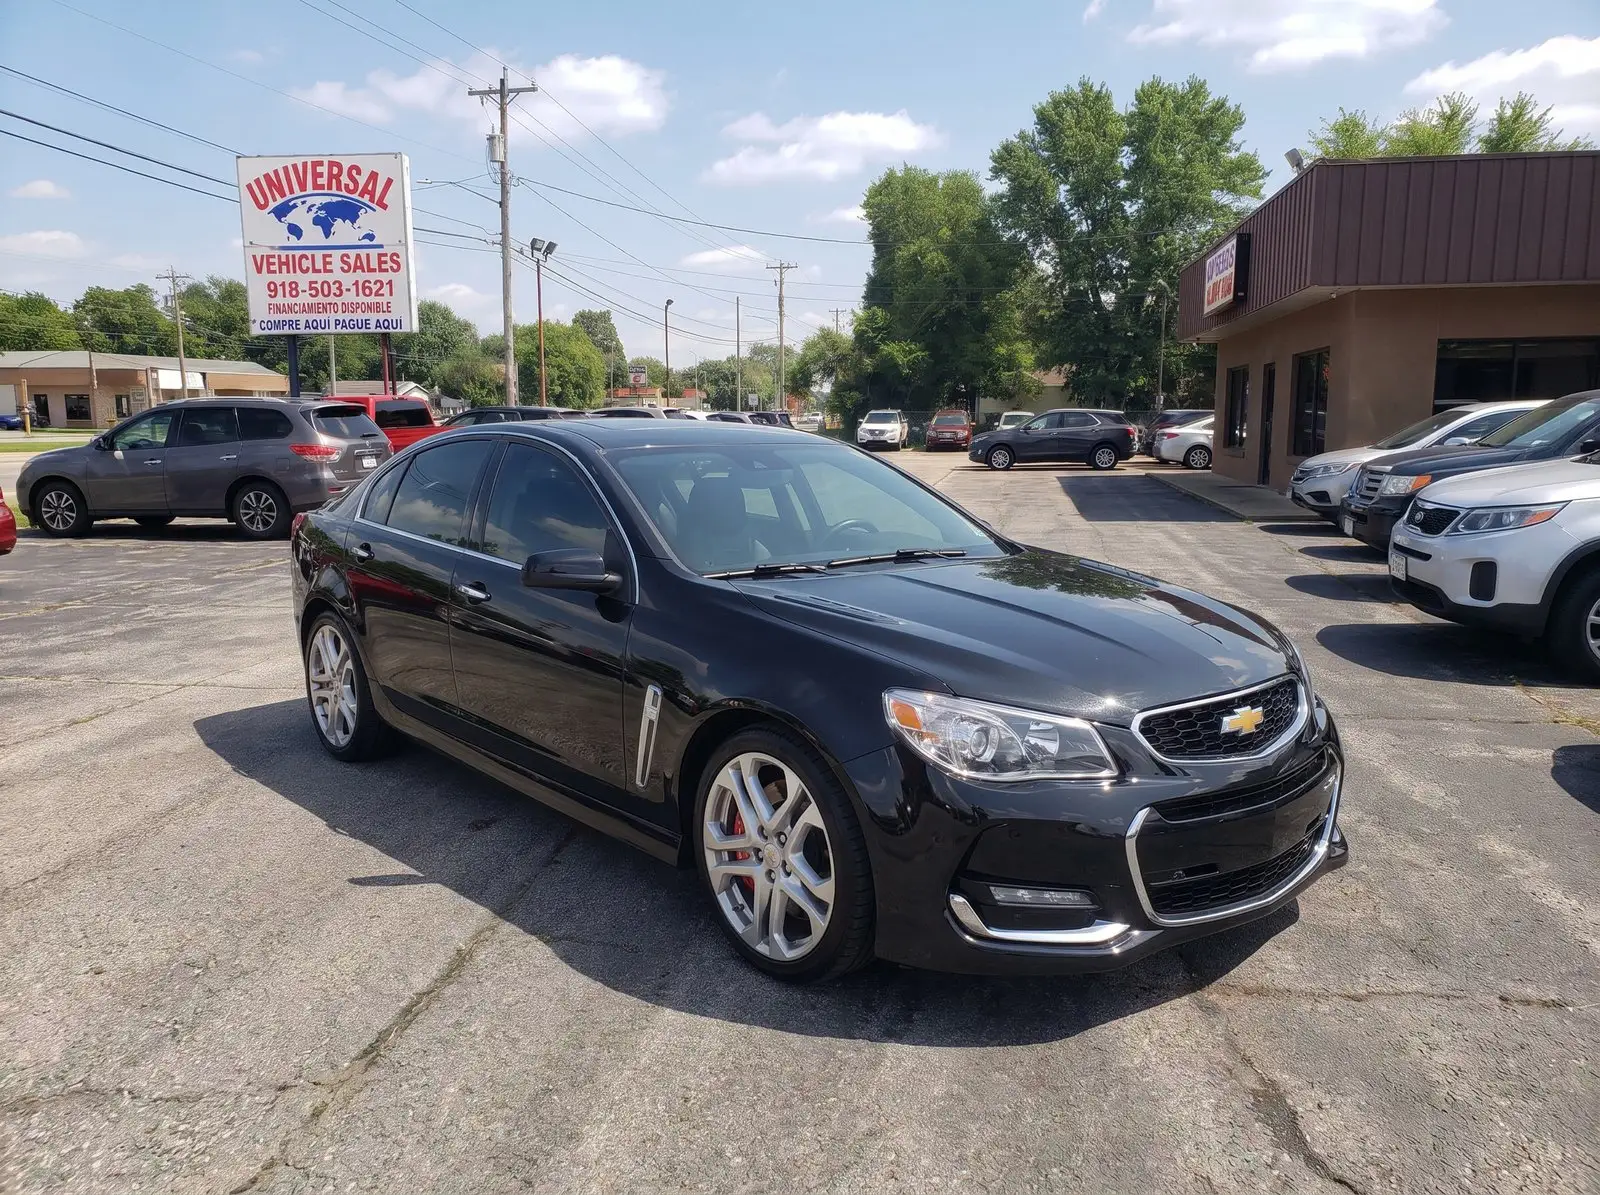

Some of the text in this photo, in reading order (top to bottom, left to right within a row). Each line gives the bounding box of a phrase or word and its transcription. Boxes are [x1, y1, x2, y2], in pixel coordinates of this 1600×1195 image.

[245, 160, 394, 211] UNIVERSAL
[252, 252, 401, 274] VEHICLE SALES
[266, 279, 394, 298] 918-503-1621
[268, 301, 392, 314] FINANCIAMIENTO DISPONIBLE
[259, 319, 301, 331] COMPRE
[334, 318, 371, 330] PAGUE
